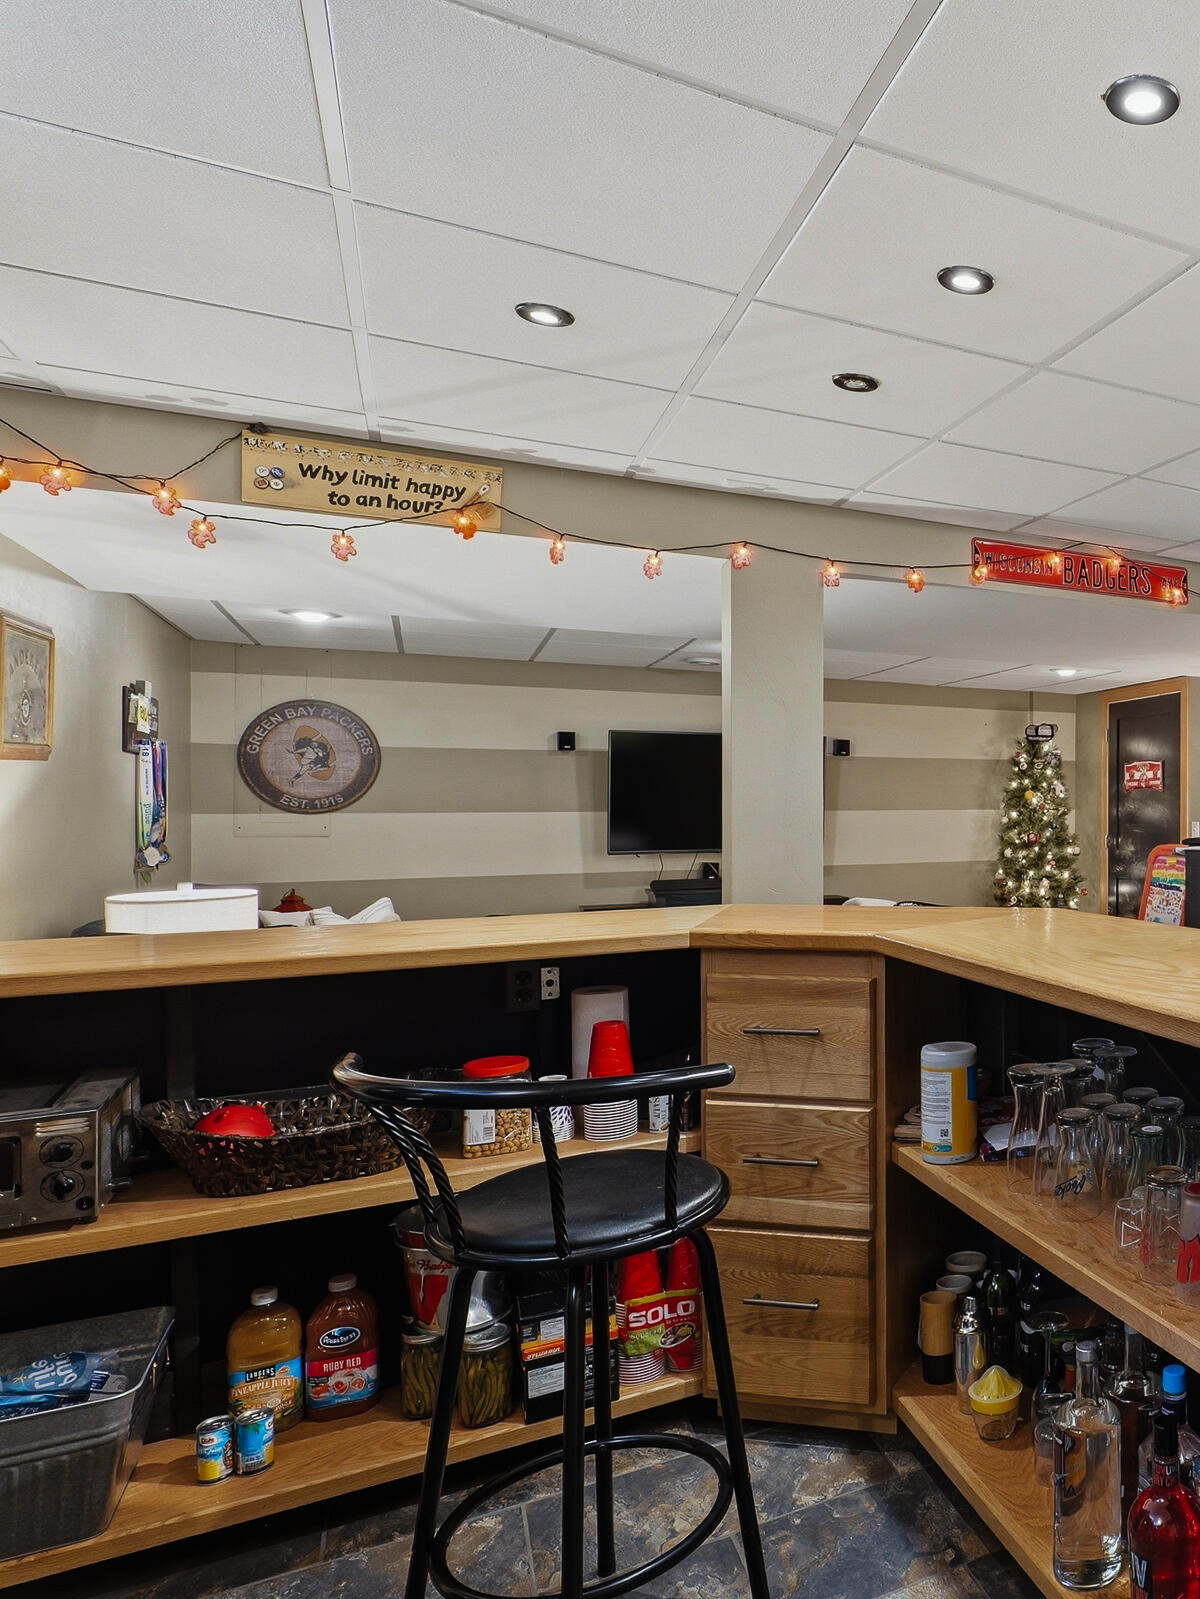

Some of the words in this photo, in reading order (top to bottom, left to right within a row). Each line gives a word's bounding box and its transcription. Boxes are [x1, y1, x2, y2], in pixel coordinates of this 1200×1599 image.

[298, 462, 348, 486] Why
[352, 469, 401, 491] limit
[406, 477, 467, 501] happy
[328, 490, 350, 506] to
[356, 495, 382, 509] an
[387, 497, 443, 515] hour?
[1063, 555, 1151, 594] BADGERS
[246, 713, 283, 754] GREEN
[285, 706, 317, 720] BAY
[320, 707, 374, 756] PACKERS
[280, 794, 310, 809] EST.
[628, 1300, 696, 1328] SOLO
[322, 1360, 345, 1373] RUBY
[346, 1356, 362, 1368] RED
